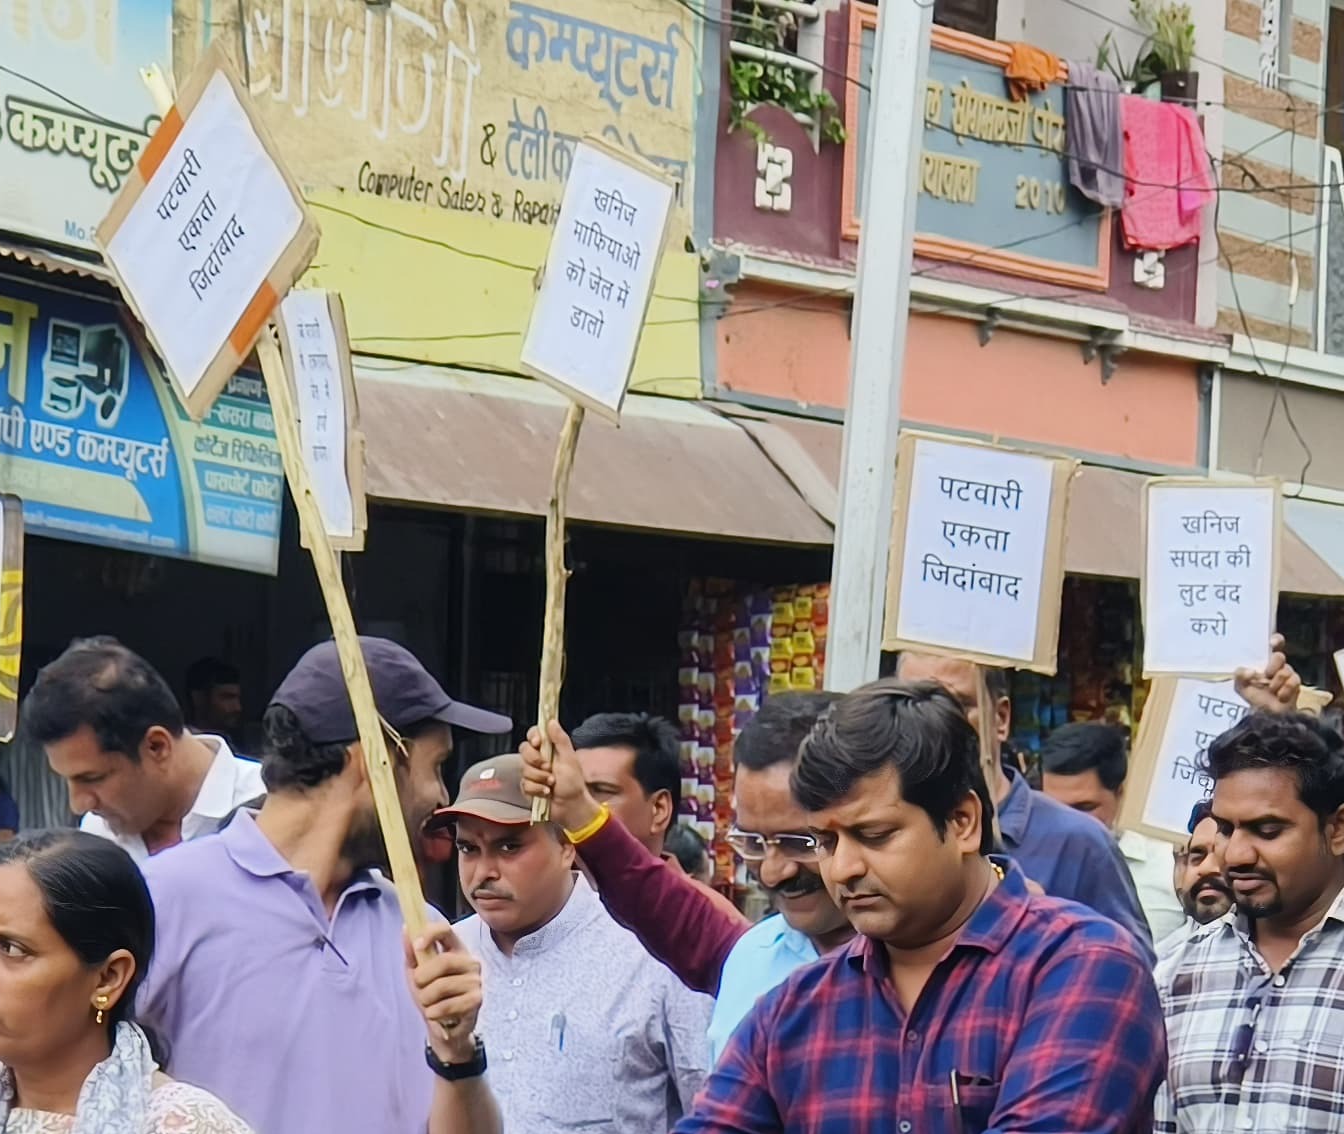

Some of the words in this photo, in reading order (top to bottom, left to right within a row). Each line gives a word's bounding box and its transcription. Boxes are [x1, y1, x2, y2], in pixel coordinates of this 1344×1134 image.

[506, 0, 681, 113] कम्प्यूटर्स
[480, 123, 498, 168] &
[156, 147, 203, 223] पटवारी
[358, 160, 434, 205] Computer
[438, 176, 486, 213] Sales
[177, 190, 218, 252] एकता
[594, 187, 638, 227] खनिज
[573, 219, 641, 272] माफियाओ
[565, 257, 586, 288] को
[588, 267, 614, 303] जेल
[616, 279, 631, 309] में
[569, 304, 606, 340] डालो
[205, 405, 251, 428] -खसरा
[29, 422, 72, 457] एण्ड
[76, 427, 171, 482] कम्प्यूटर्स
[938, 475, 1023, 510] पटवारी
[941, 520, 1011, 552] एकता
[1181, 510, 1241, 535] खनिज
[1225, 544, 1252, 569] की
[1178, 583, 1207, 608] लुट
[1190, 612, 1229, 637] करो
[1198, 694, 1249, 720] पटवा
